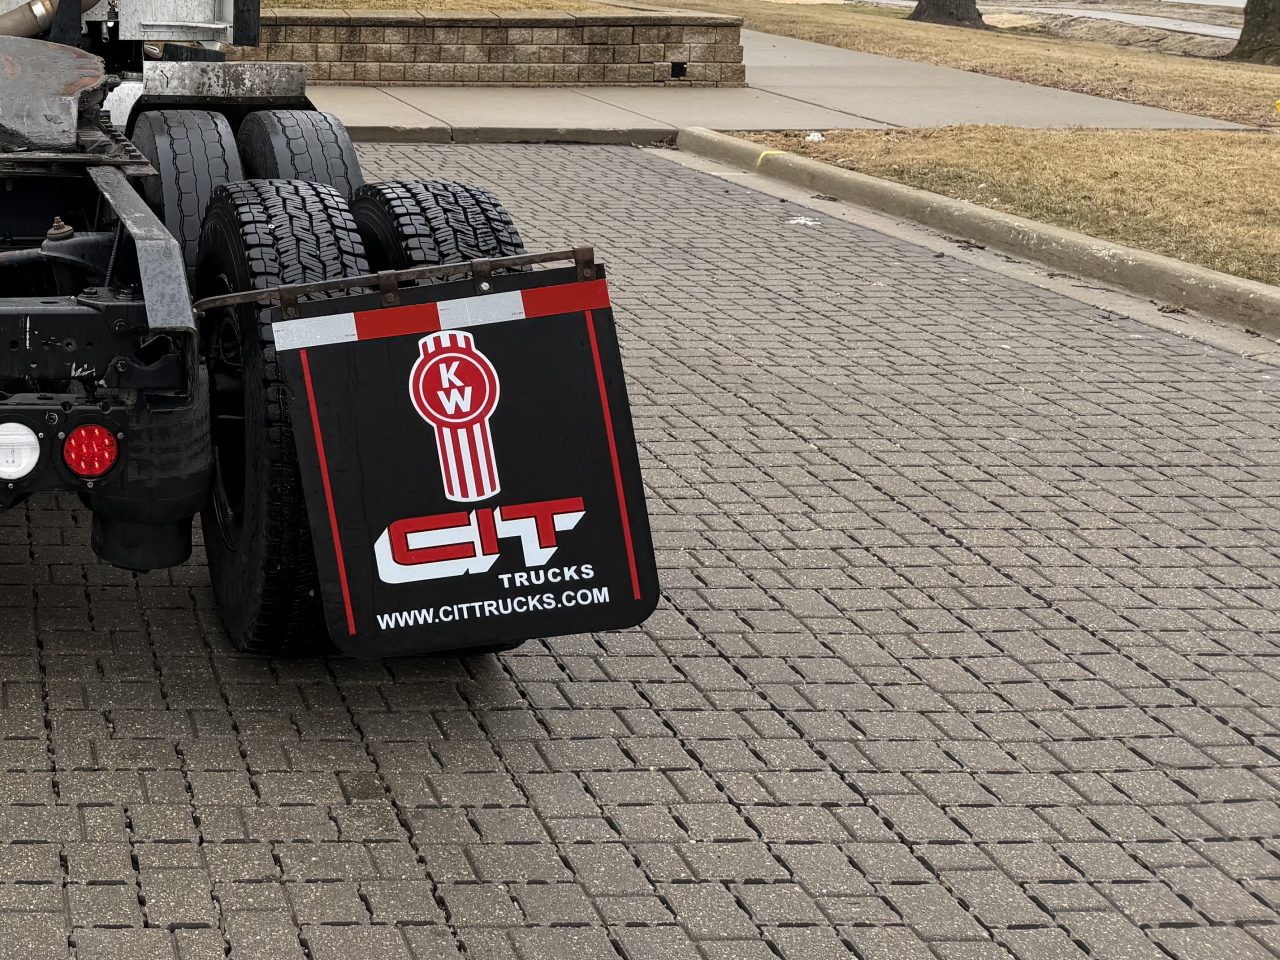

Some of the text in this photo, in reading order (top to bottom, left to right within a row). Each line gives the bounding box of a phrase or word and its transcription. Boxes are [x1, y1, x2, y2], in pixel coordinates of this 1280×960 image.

[439, 361, 464, 388] K
[436, 388, 474, 415] W
[373, 496, 587, 584] CIT
[498, 563, 595, 589] TRUCKS
[376, 586, 611, 631] WWW.CITTRUCKS.COM
